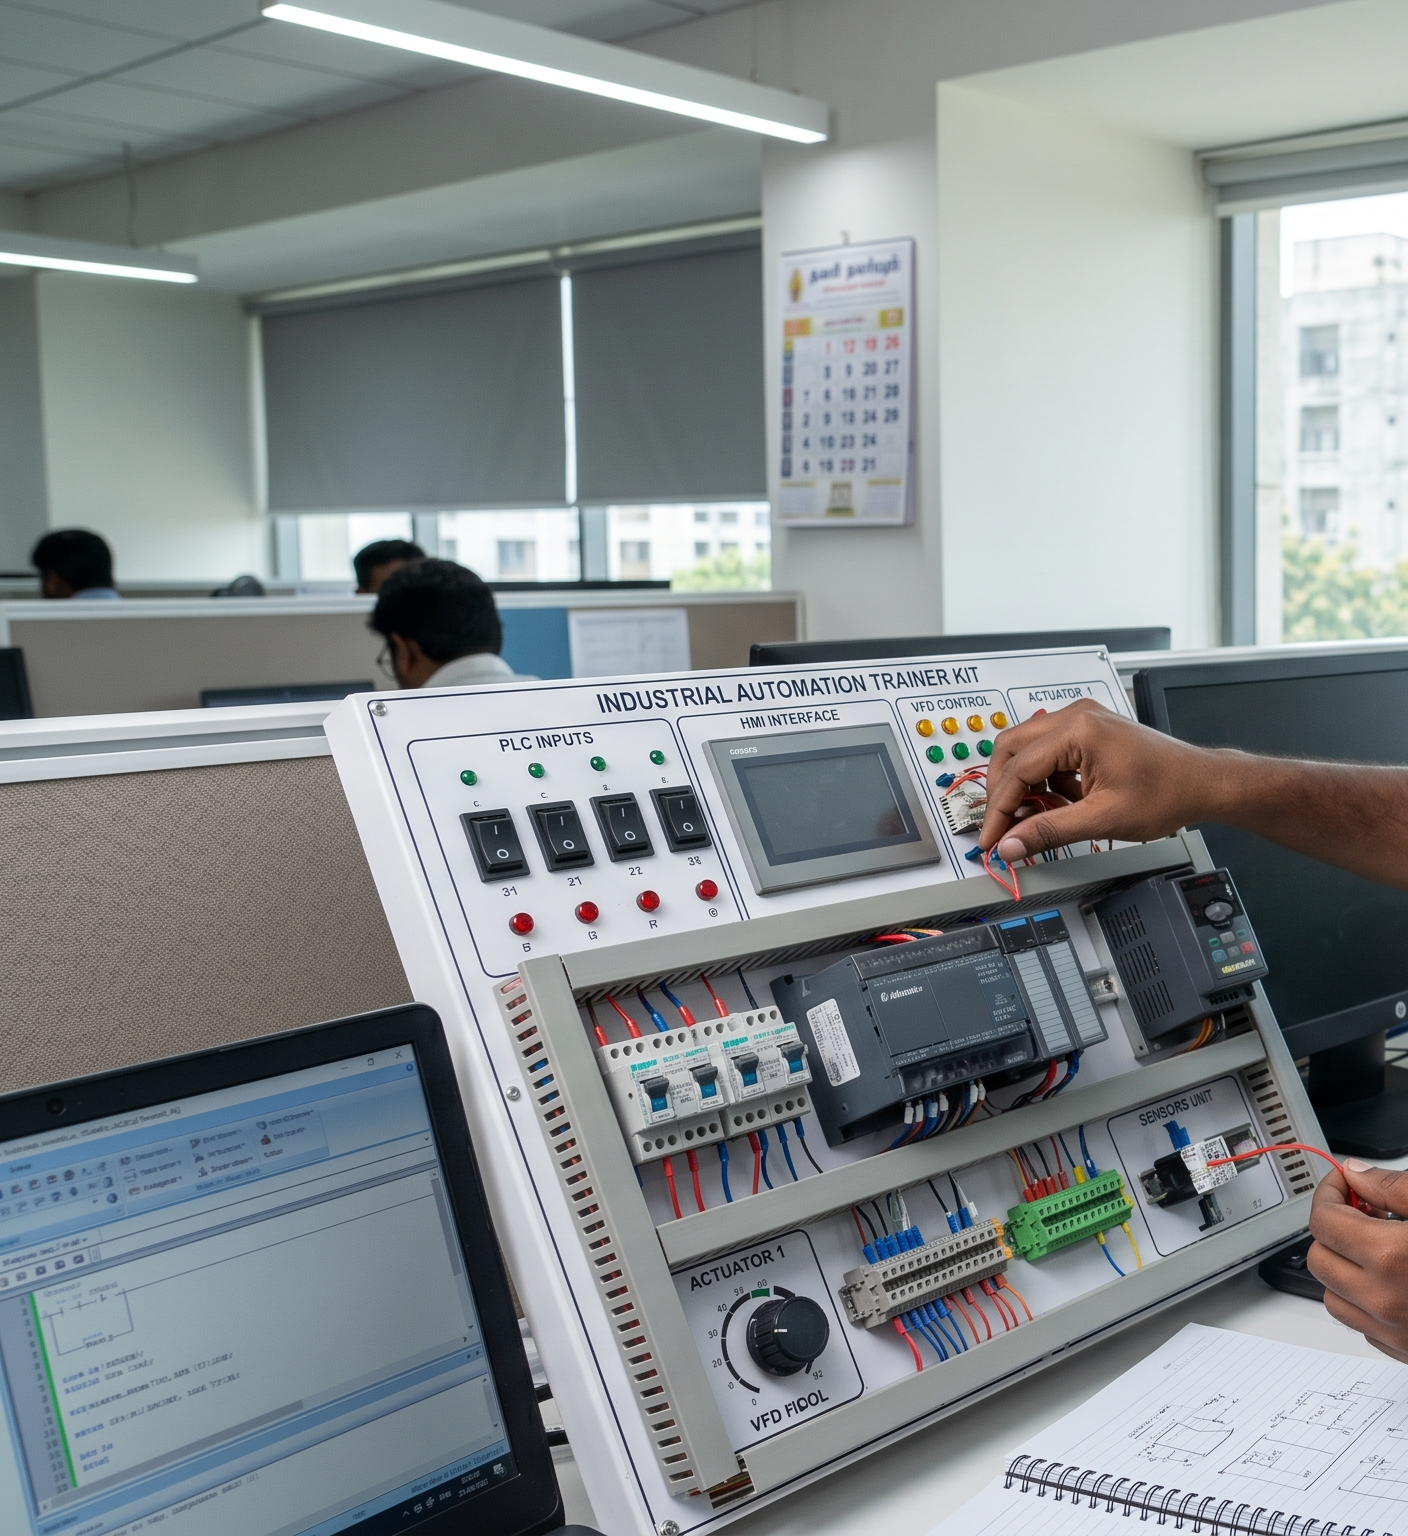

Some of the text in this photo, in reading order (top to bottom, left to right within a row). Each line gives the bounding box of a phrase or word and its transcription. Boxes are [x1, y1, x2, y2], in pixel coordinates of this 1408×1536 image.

[596, 666, 979, 714] INDUSTRIAL AUTOMATION TRAINER KIT
[1028, 687, 1093, 703] ACTUATOR 1
[910, 695, 992, 713] VFD CONTROL
[740, 709, 840, 730] HMI INTERFACE
[499, 731, 594, 752] PLC INPUTS
[567, 876, 583, 887] 21
[649, 919, 658, 929] R
[1138, 1089, 1213, 1127] SENSORS UNIT
[690, 1245, 786, 1292] ACTUATOR 1
[712, 1358, 723, 1368] 20
[751, 1398, 757, 1406] 0
[750, 1409, 783, 1432] VFD
